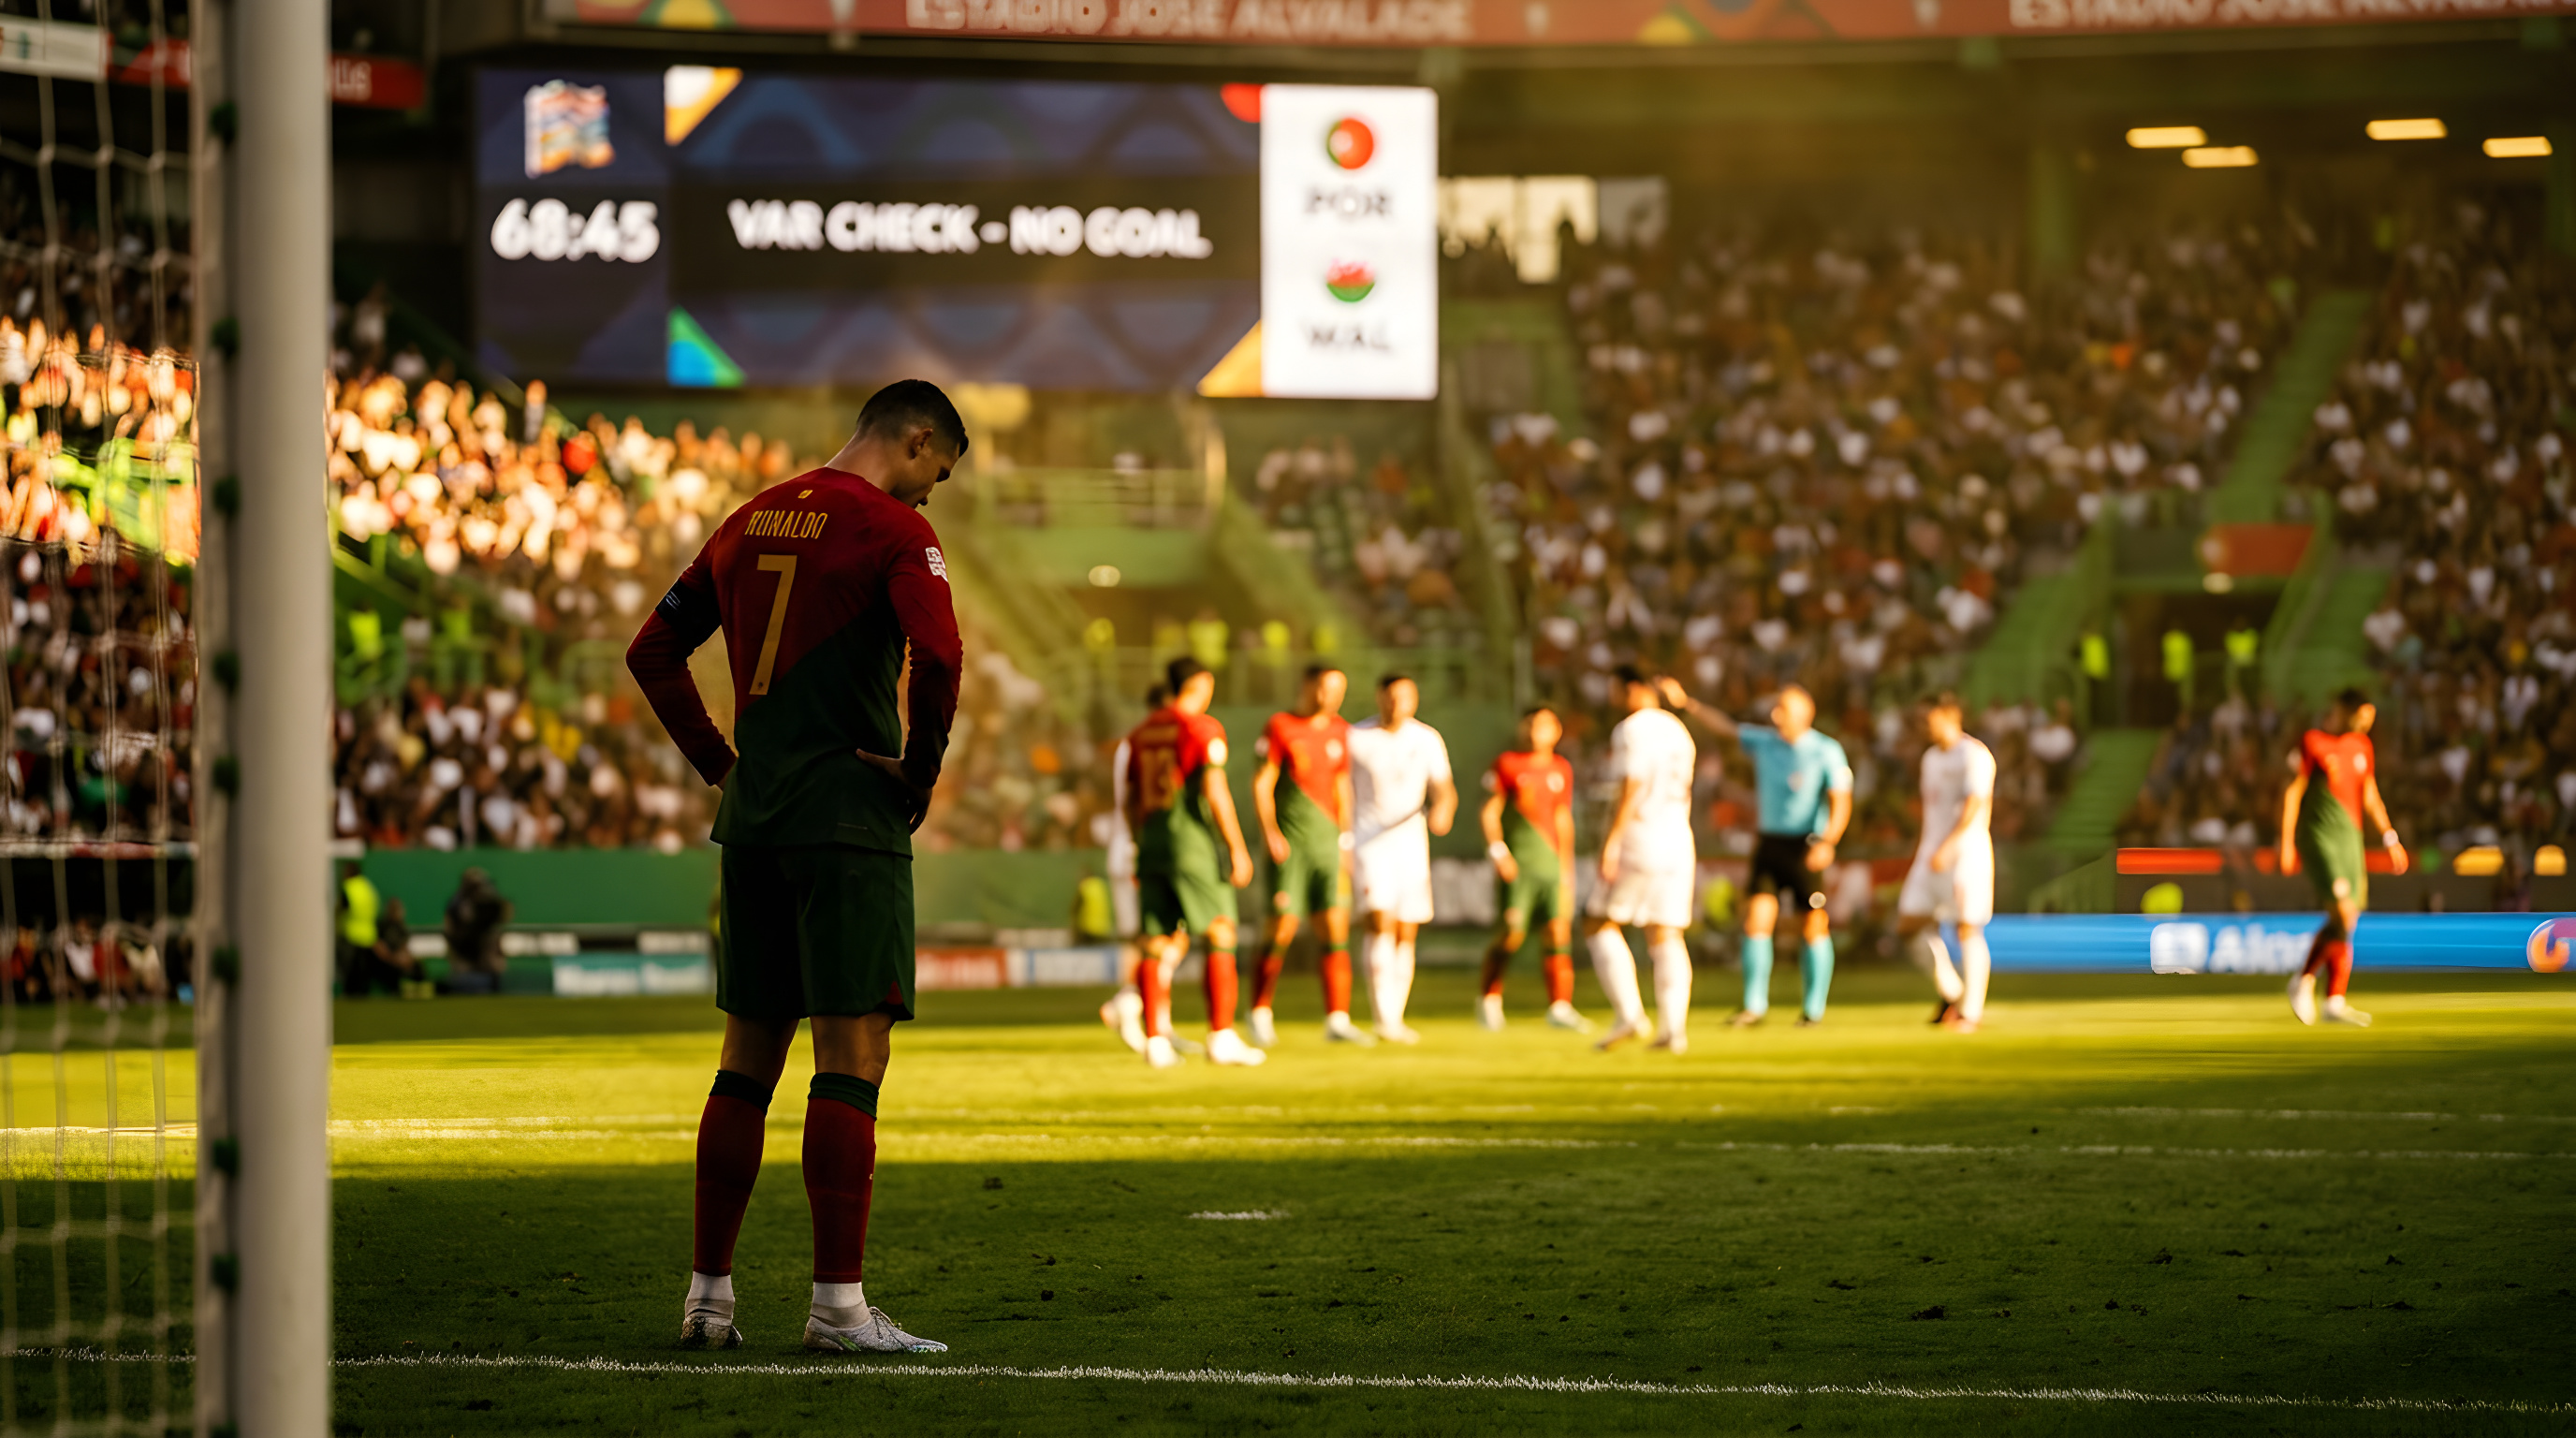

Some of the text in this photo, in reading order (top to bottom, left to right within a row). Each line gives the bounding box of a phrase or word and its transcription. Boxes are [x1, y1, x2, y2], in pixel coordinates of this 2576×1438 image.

[490, 198, 661, 263] 68:45
[727, 198, 825, 251] VAR
[825, 200, 980, 254] CHECK
[1009, 204, 1084, 257] NO
[1084, 205, 1214, 259] GOAL
[1303, 184, 1393, 221] POR
[1299, 318, 1394, 355] WAL
[749, 554, 798, 695] 7
